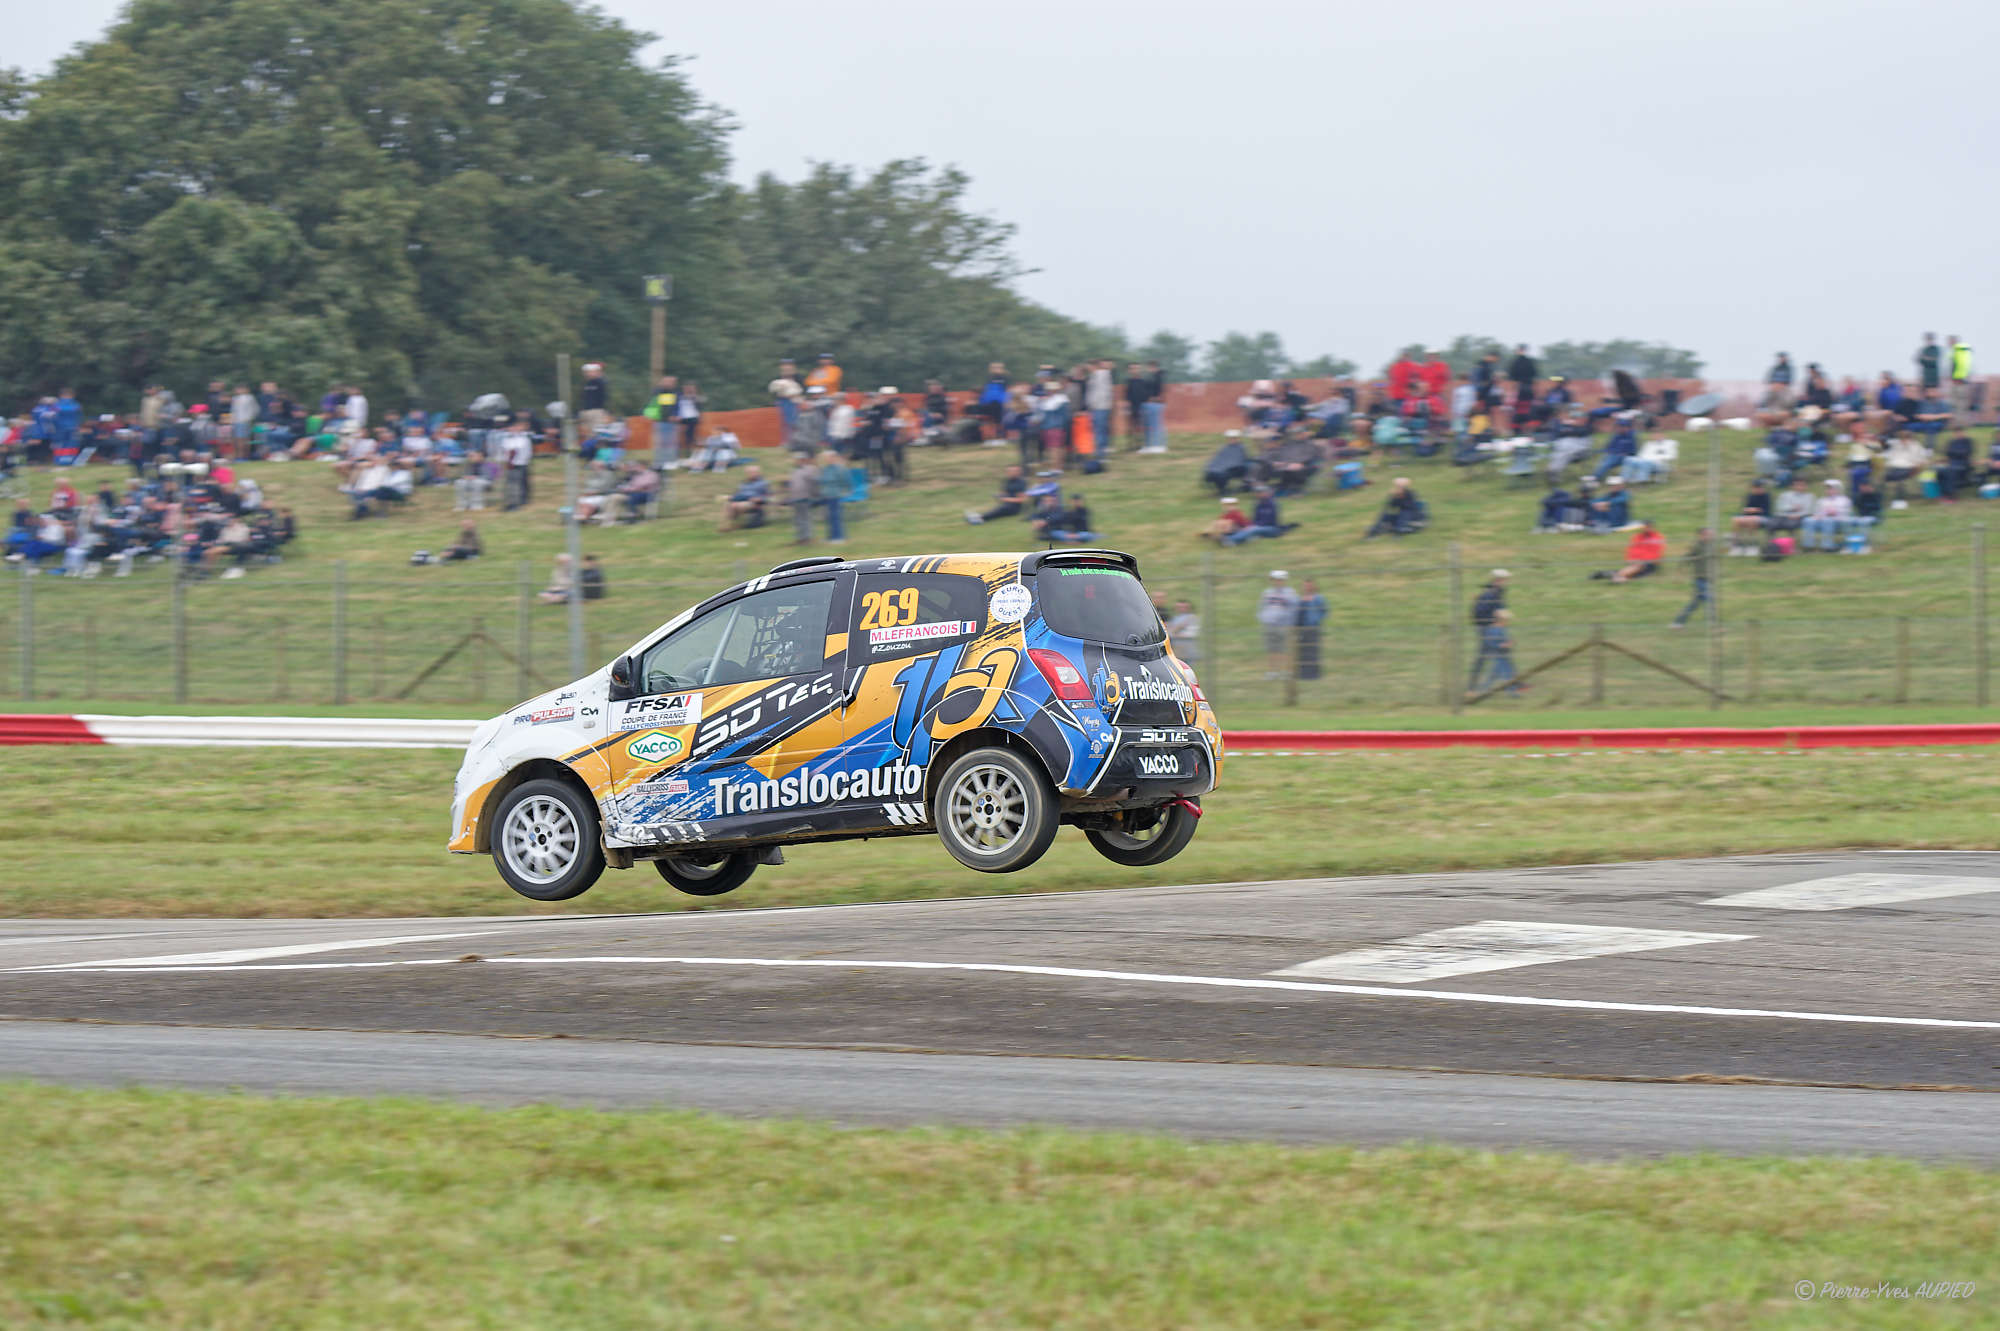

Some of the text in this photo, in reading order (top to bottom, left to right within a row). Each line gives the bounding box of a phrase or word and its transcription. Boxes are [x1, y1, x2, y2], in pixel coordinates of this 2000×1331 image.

[1001, 585, 1024, 595] EURO
[859, 587, 920, 631] 269
[1123, 676, 1194, 703] Translocauto
[625, 696, 683, 714] FFSA
[621, 711, 688, 725] COUPE DE FRANCE
[634, 740, 678, 755] YACCO
[1138, 754, 1179, 775] YACCO
[708, 758, 922, 816] Translocauto
